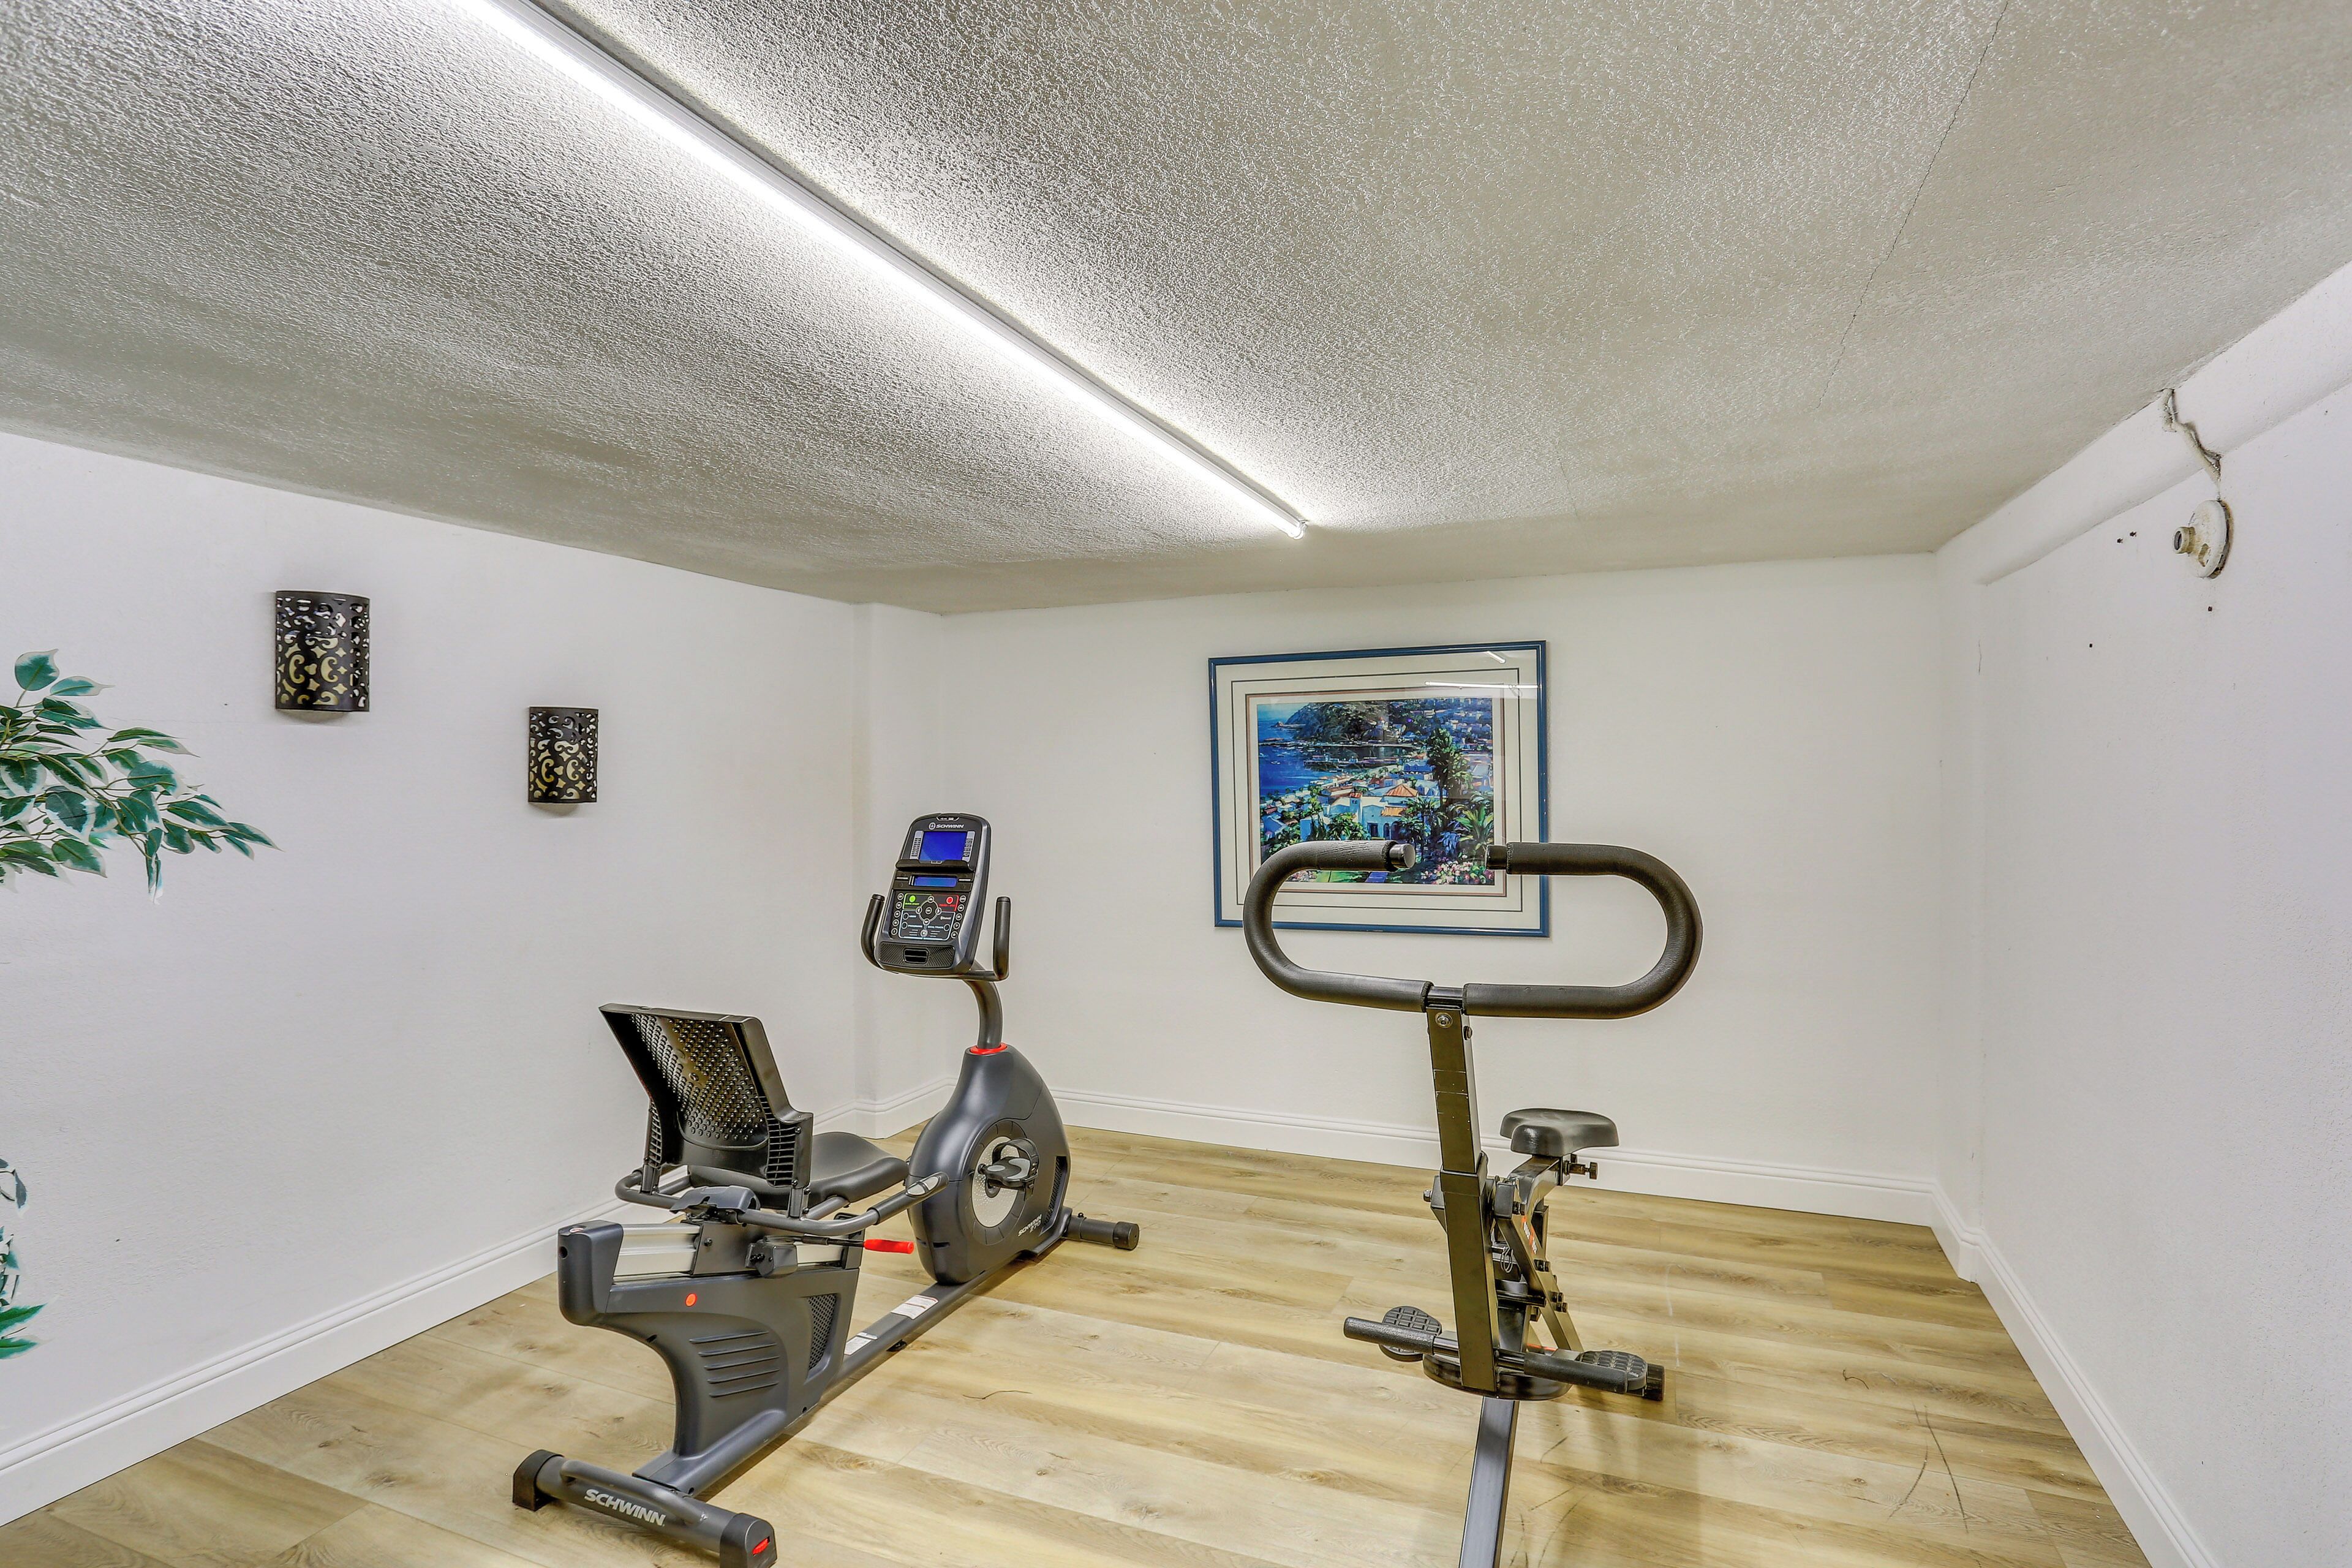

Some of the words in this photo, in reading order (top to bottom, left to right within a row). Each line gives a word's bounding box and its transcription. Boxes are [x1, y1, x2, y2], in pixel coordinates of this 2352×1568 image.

[1018, 1214, 1042, 1237] SCHWINN
[1030, 1219, 1041, 1233] 270
[584, 1489, 666, 1526] SCHWINN
